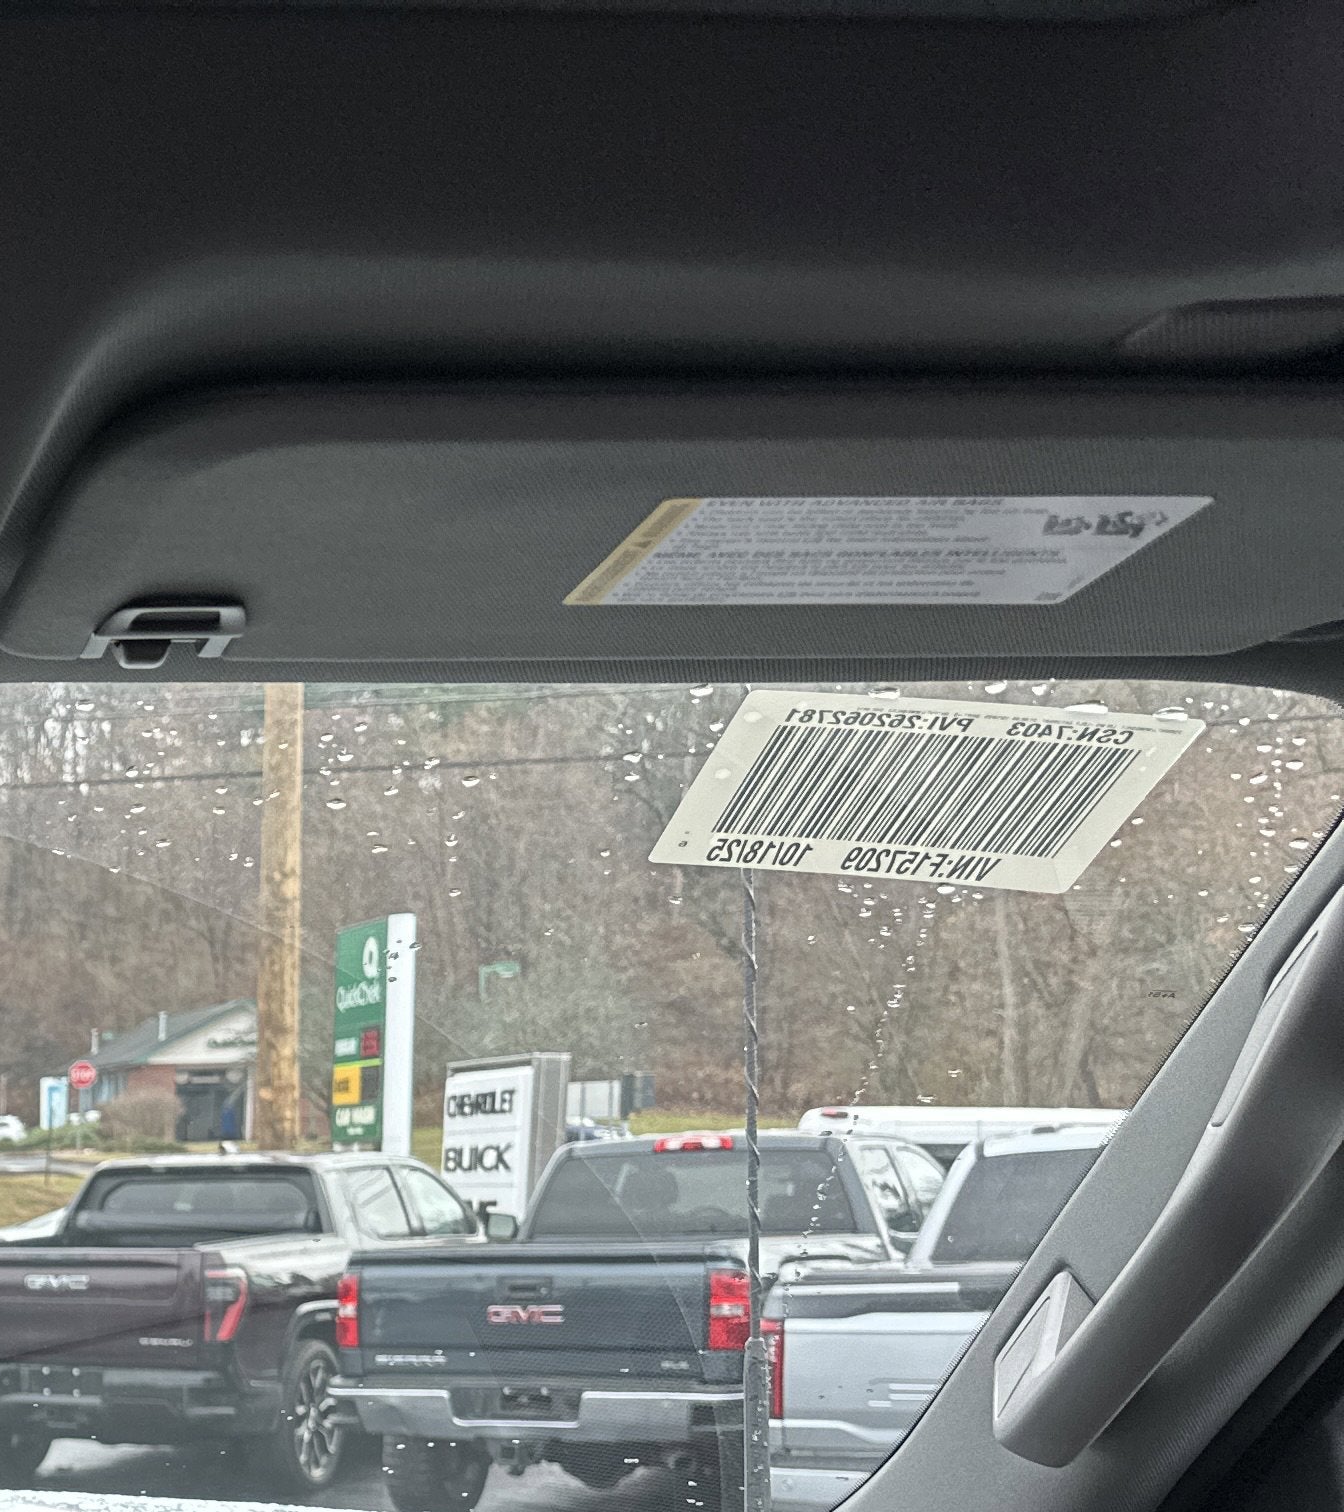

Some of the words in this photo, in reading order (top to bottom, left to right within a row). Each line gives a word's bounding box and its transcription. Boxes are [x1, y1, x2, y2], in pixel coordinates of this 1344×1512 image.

[447, 1089, 516, 1117] CHEVROLET
[444, 1142, 513, 1171] BUICK
[24, 1273, 91, 1290] GMC
[487, 1303, 565, 1326] GMC
